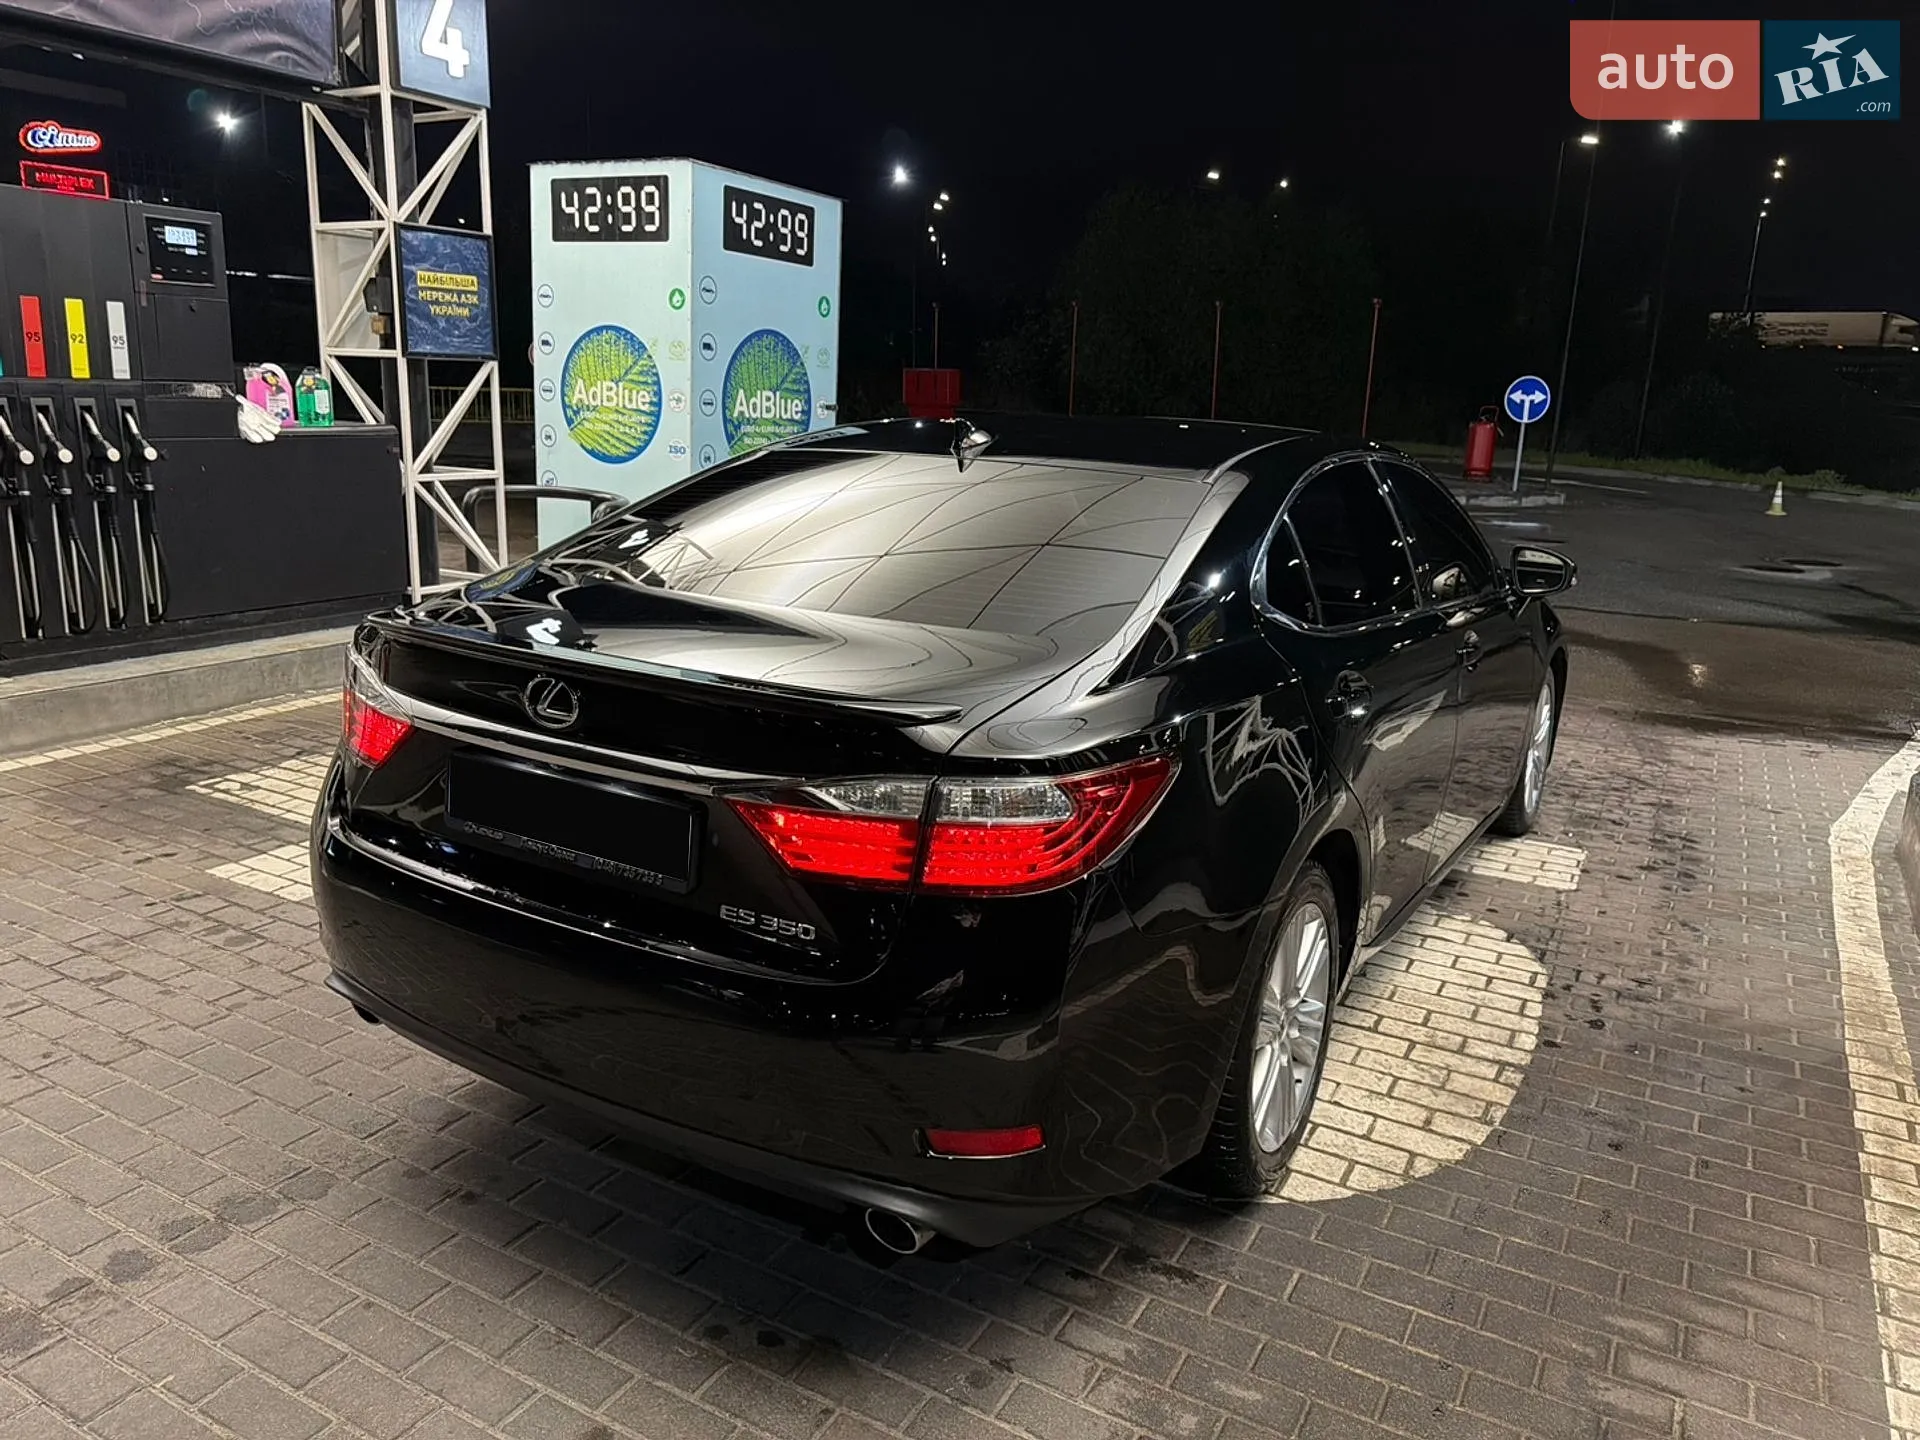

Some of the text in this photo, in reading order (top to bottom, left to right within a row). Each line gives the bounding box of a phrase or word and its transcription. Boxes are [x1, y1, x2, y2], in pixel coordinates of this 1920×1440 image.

[421, 0, 470, 79] 4
[420, 273, 476, 288] НАЙБІЛЬША
[418, 290, 478, 304] МЕРЕЖА АЗК
[429, 304, 470, 317] УКРАЇНИ
[25, 330, 41, 343] 95
[70, 332, 85, 345] 92
[112, 335, 126, 346] 95
[572, 377, 651, 412] AdBlue
[733, 387, 803, 421] AdBlue
[668, 444, 687, 455] ISO
[719, 904, 816, 940] ES 350
